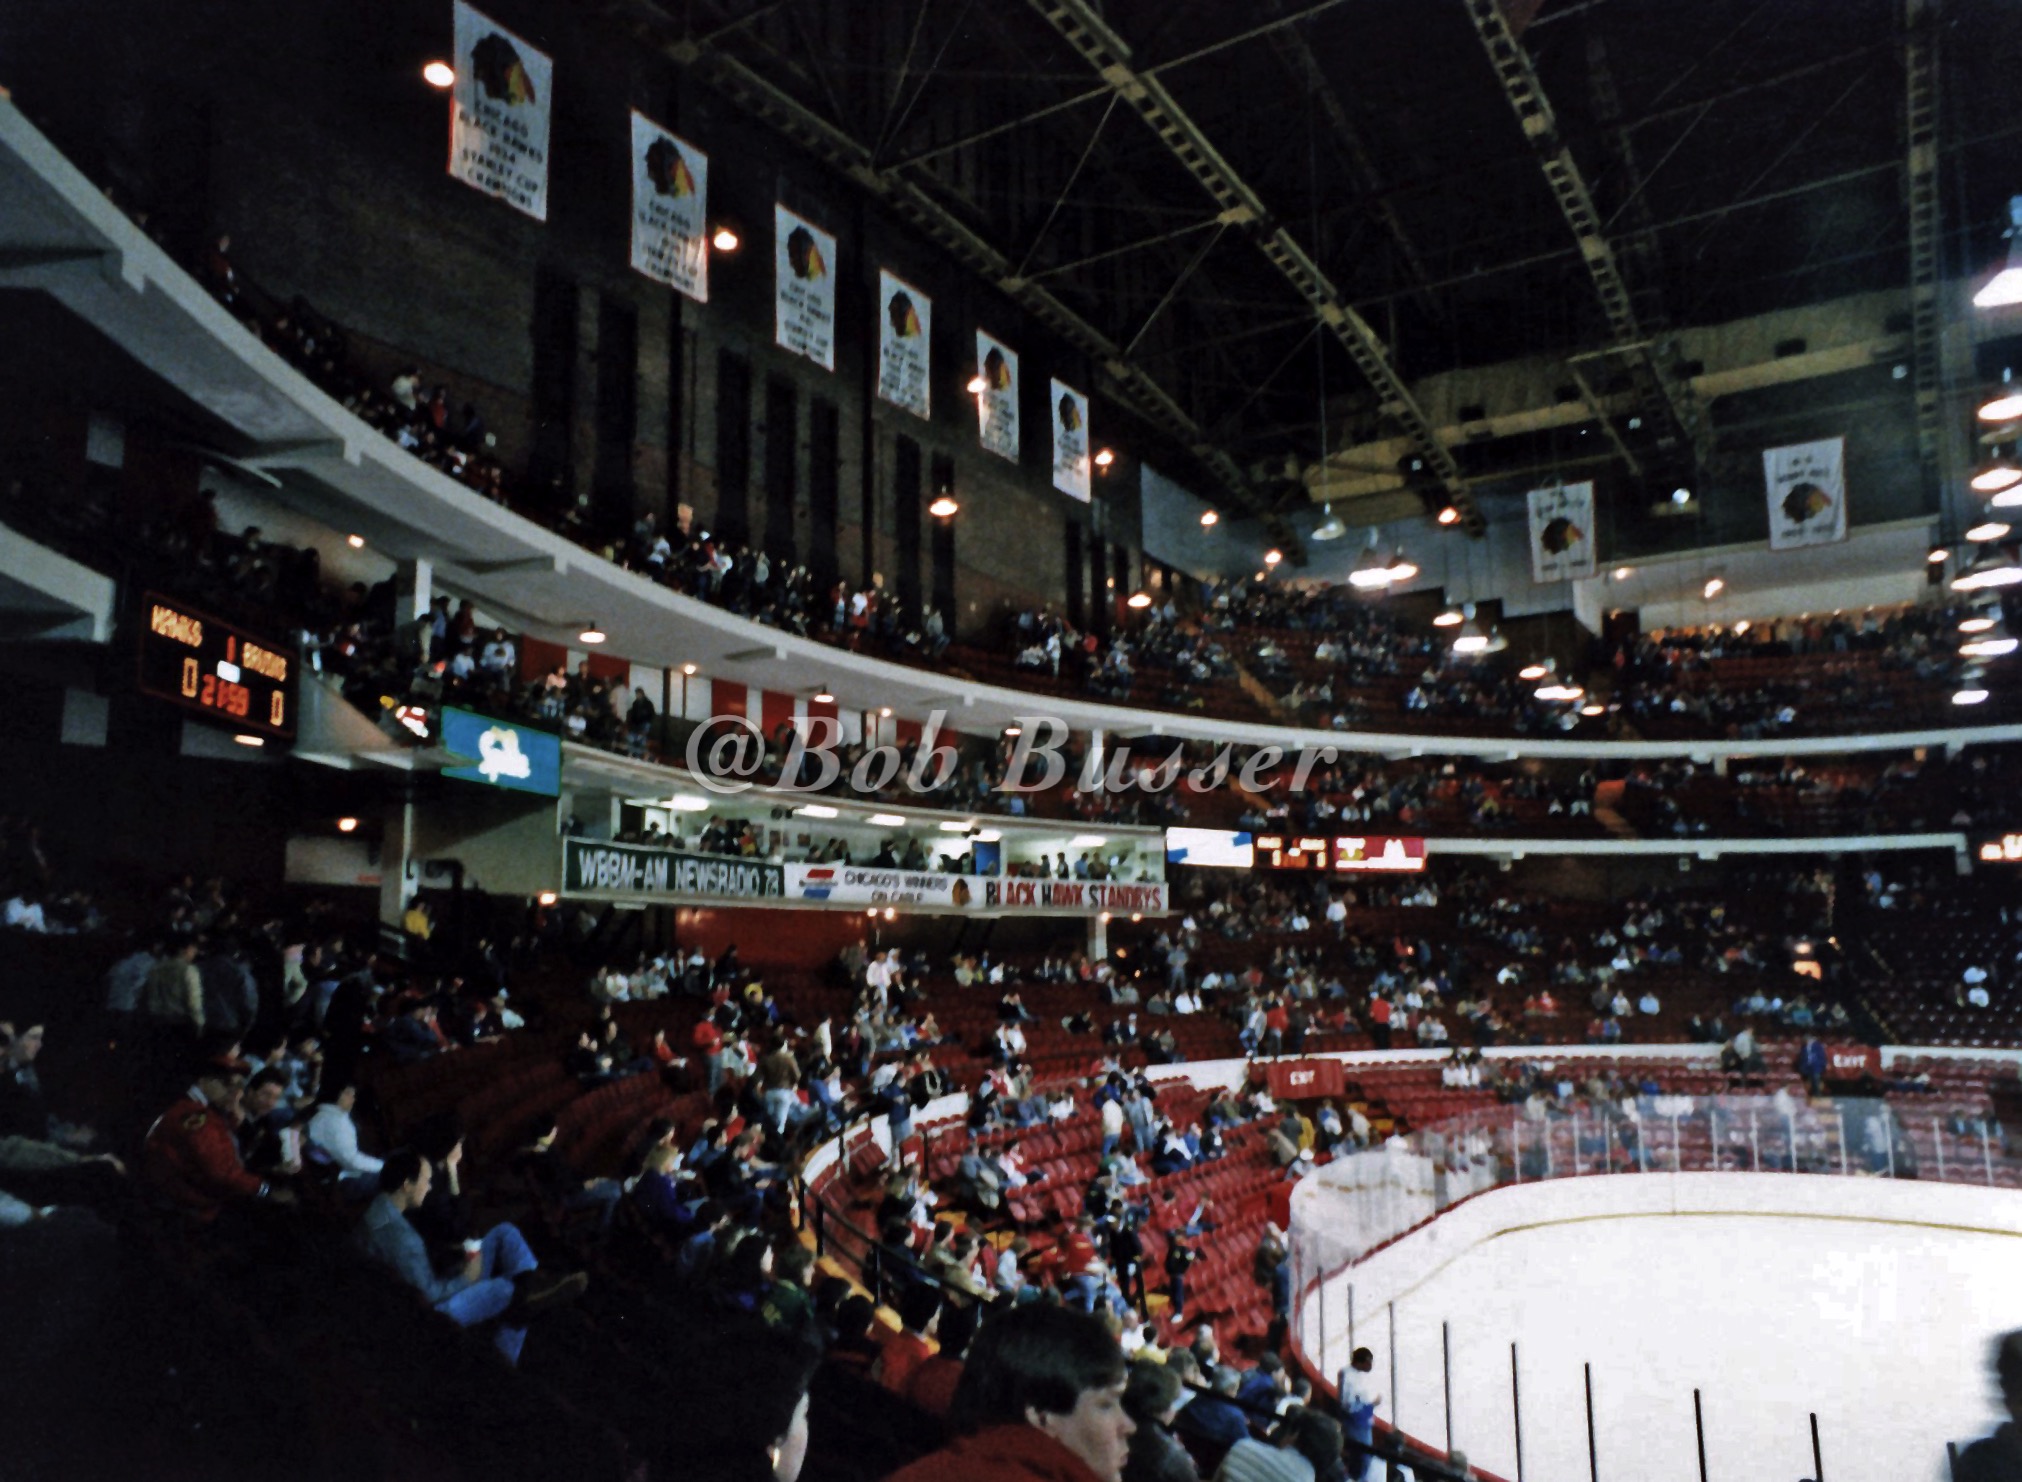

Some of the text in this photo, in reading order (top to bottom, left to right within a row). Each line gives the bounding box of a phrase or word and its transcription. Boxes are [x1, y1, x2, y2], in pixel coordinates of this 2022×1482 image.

[578, 848, 668, 892] WBBM-AM
[675, 858, 760, 898] NEWSRADIO
[985, 880, 1162, 912] BLACK HAWK STANDBYS
[1831, 1052, 1868, 1069] EXIT
